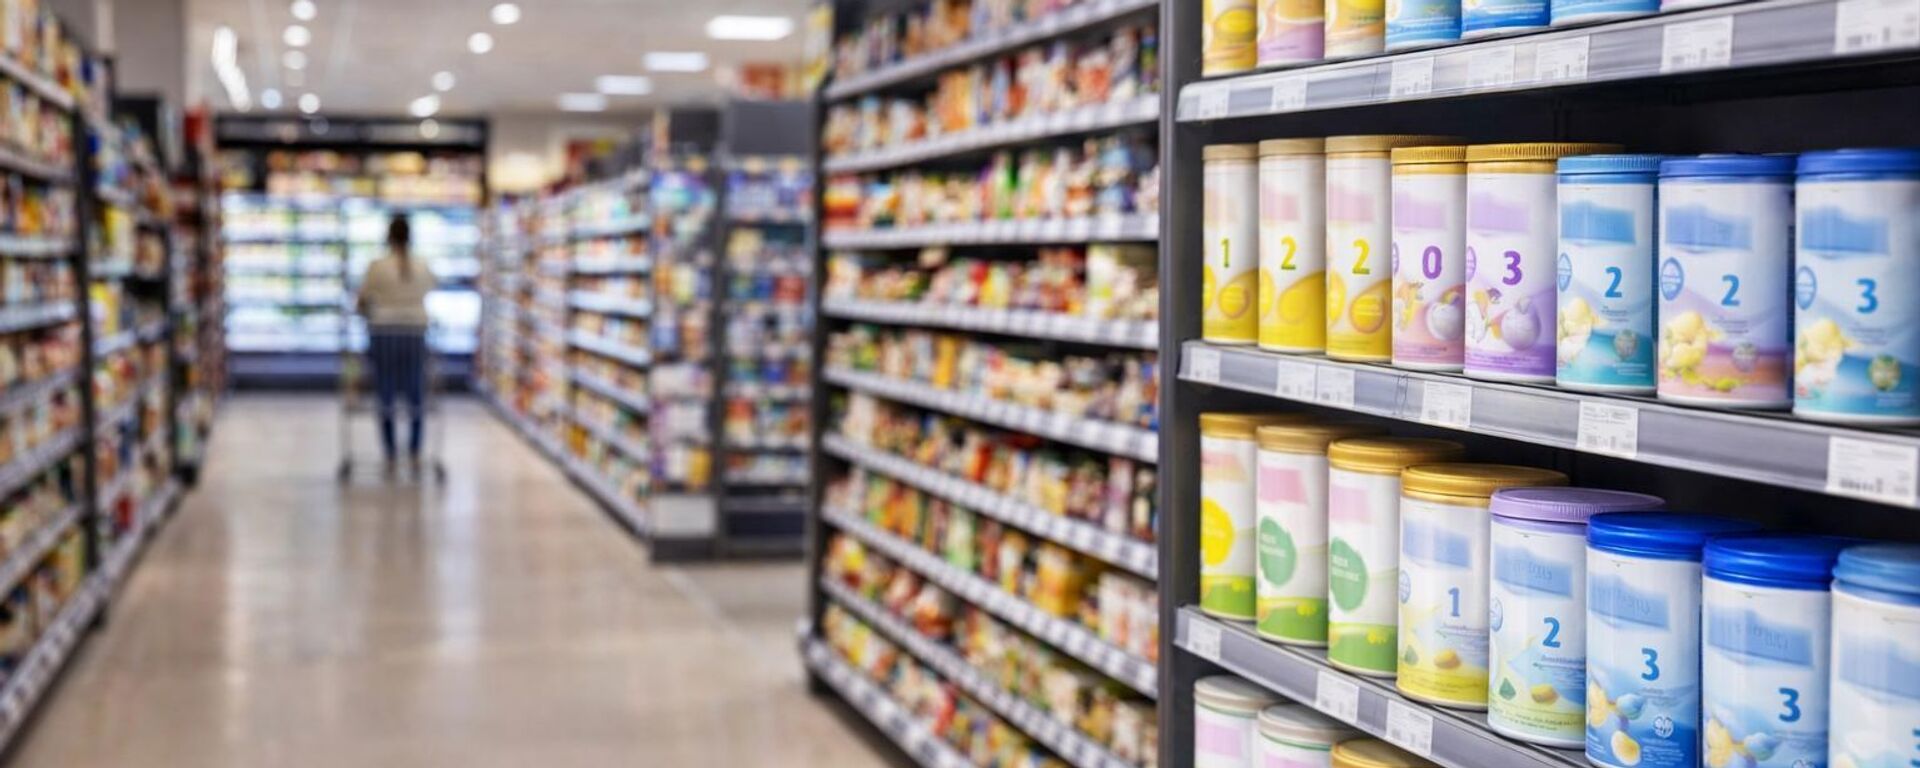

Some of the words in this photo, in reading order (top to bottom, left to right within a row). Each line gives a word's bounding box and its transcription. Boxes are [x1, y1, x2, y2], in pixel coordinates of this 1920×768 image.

[1221, 238, 1231, 268] 1
[1281, 236, 1297, 270] 2
[1352, 239, 1370, 275] 2
[1422, 245, 1443, 280] 0
[1502, 250, 1523, 286] 3
[1604, 266, 1623, 298] 2
[1721, 274, 1740, 306] 2
[1855, 278, 1878, 314] 3
[1448, 587, 1461, 617] 1
[1542, 617, 1561, 648] 2
[1641, 648, 1660, 681] 3
[1778, 687, 1802, 723] 3
